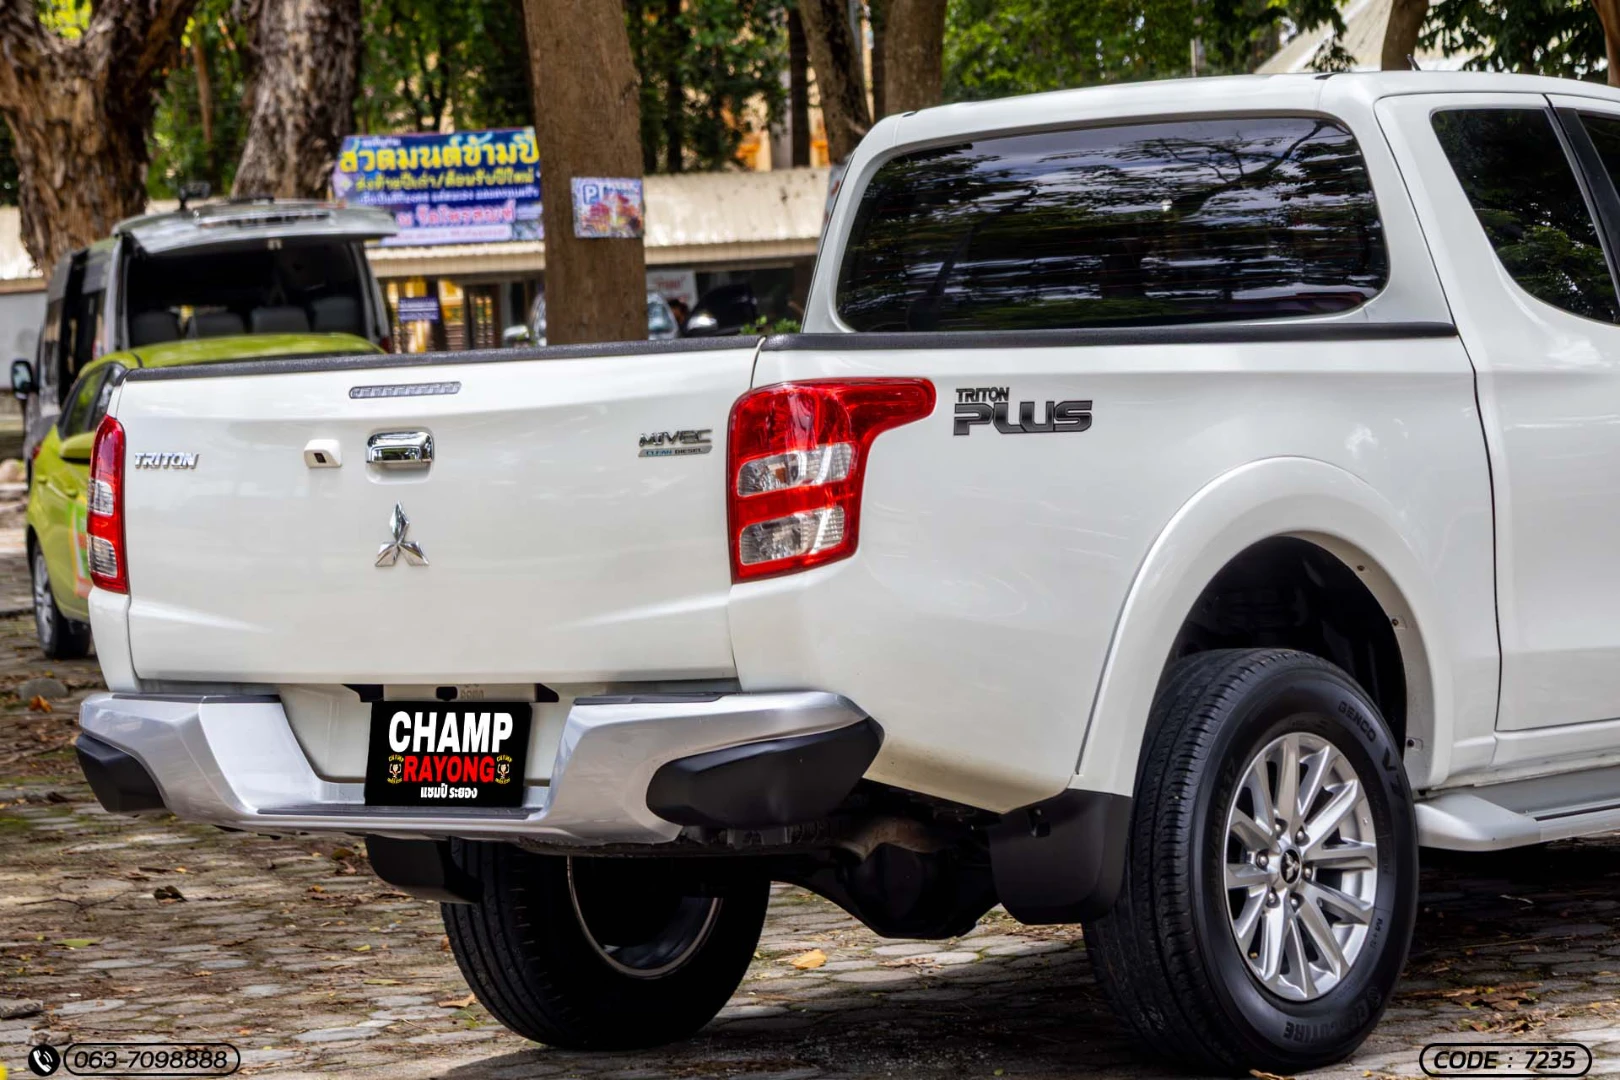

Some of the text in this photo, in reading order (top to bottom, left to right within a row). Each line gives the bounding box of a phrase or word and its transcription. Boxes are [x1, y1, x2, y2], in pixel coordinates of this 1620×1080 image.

[339, 126, 539, 172] สวดมนต์ข้ามปี
[956, 387, 1009, 402] TRITON
[953, 400, 1092, 435] PLUS
[639, 429, 712, 447] MIVEC
[135, 452, 199, 469] TRITON
